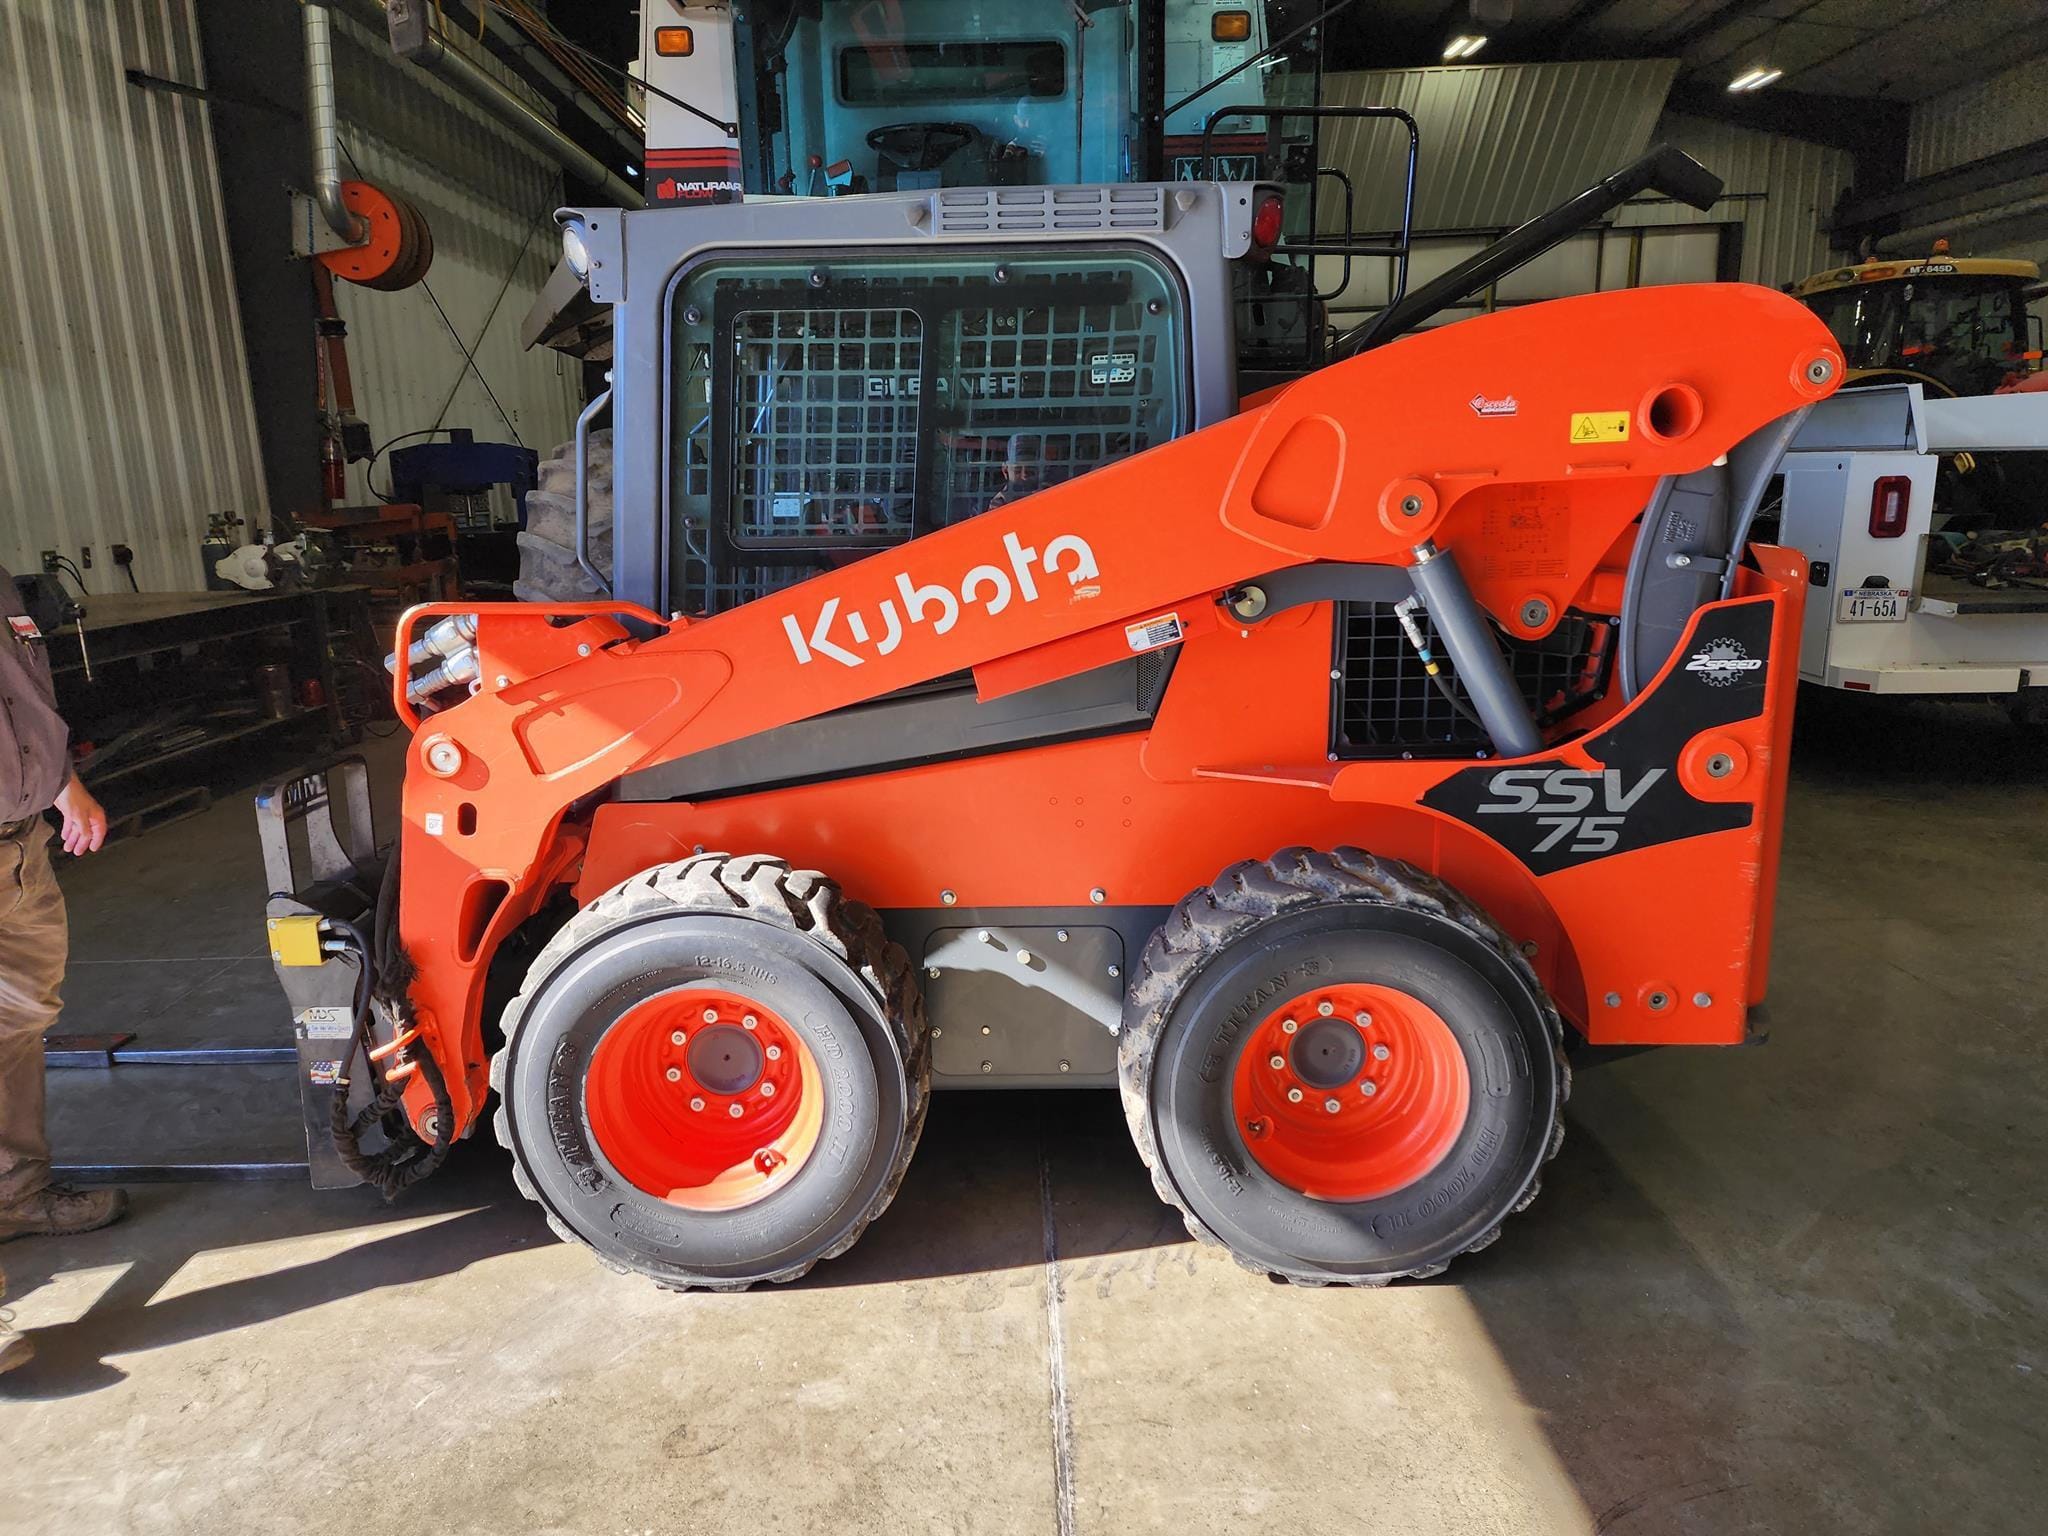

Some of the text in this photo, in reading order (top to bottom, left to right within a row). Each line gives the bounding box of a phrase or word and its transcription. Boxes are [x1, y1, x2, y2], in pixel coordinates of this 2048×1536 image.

[781, 531, 1101, 667] Kubota
[1849, 599, 1897, 617] 41-65A
[1476, 768, 1668, 814] SSV
[1531, 816, 1625, 853] 75
[1213, 971, 1290, 1045] TITAN
[814, 1025, 844, 1060] HD
[833, 1067, 856, 1133] 2000
